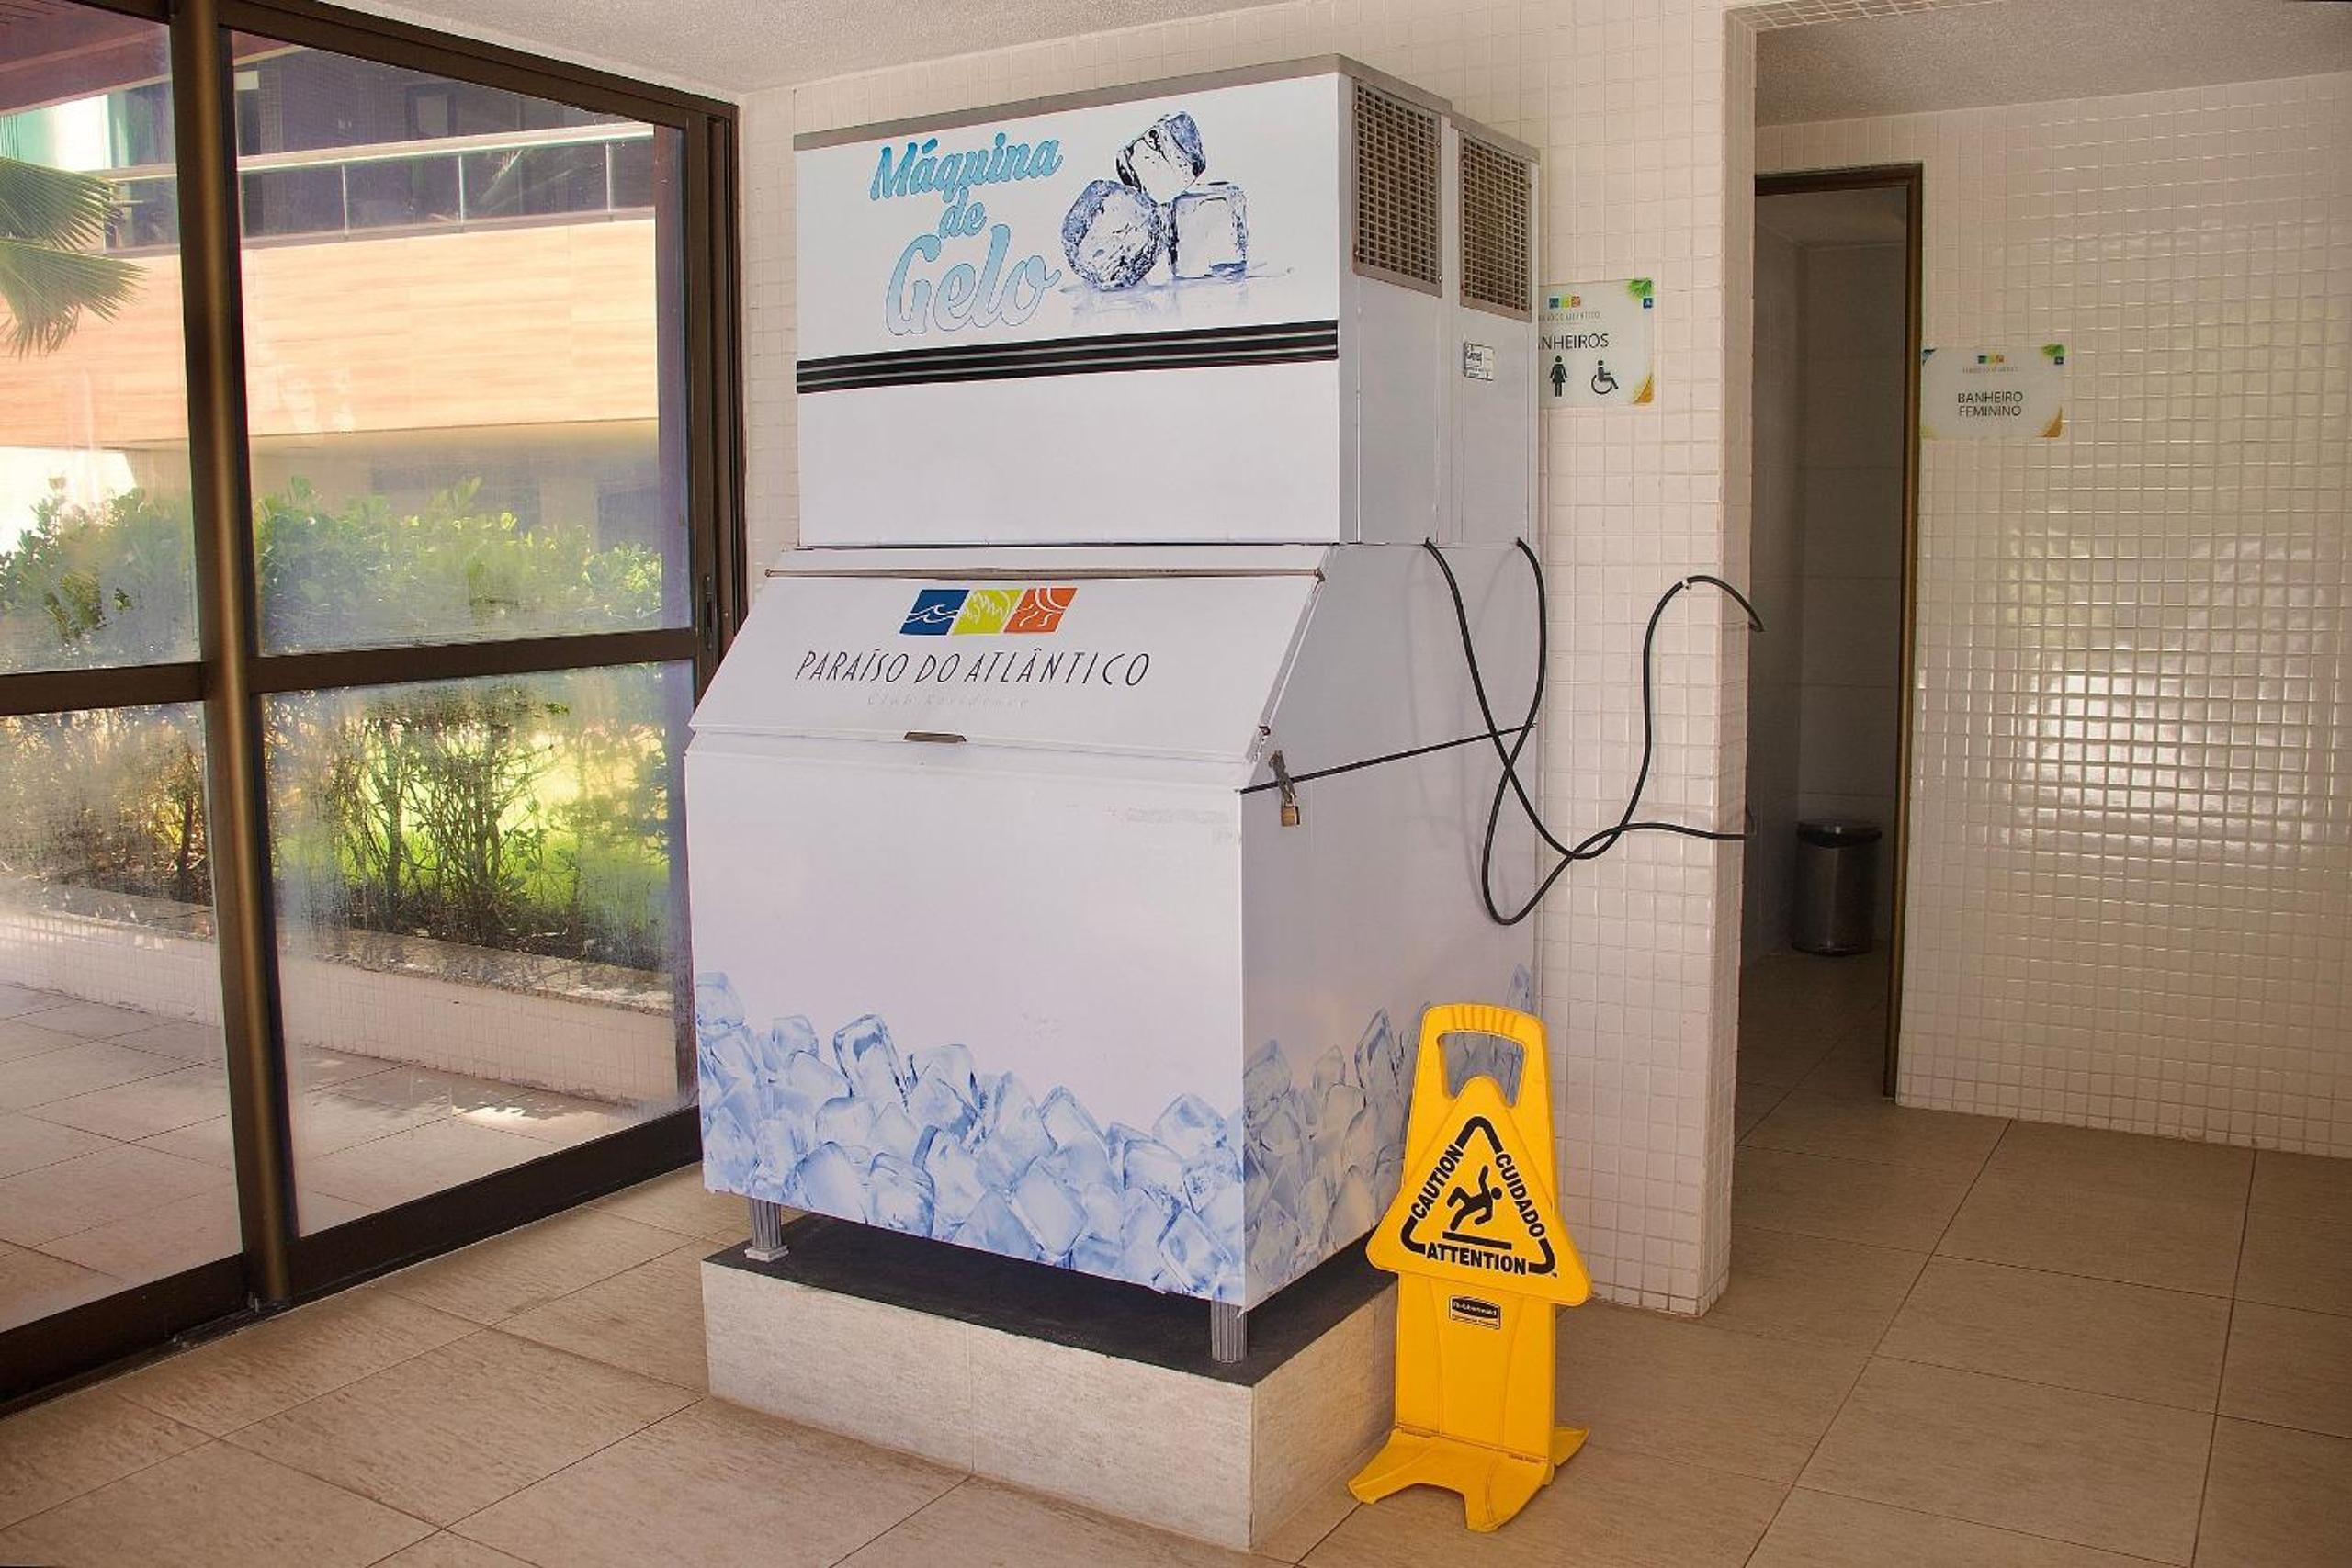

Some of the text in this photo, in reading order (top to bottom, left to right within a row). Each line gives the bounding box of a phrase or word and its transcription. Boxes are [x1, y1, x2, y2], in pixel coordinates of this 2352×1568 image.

[869, 132, 1065, 203] Máquina
[939, 187, 987, 238] de
[886, 223, 1062, 336] Gelo
[1538, 333, 1610, 350] NHEIROS
[1957, 391, 2024, 404] BANHEIRO
[1959, 405, 2022, 418] FEMININO
[795, 647, 1150, 686] PARAÍSO DO ATLÂNTICO
[1410, 1143, 1464, 1220] CAUTION
[1495, 1151, 1545, 1238] CUIDADO
[1426, 1241, 1527, 1276] ATTENTION
